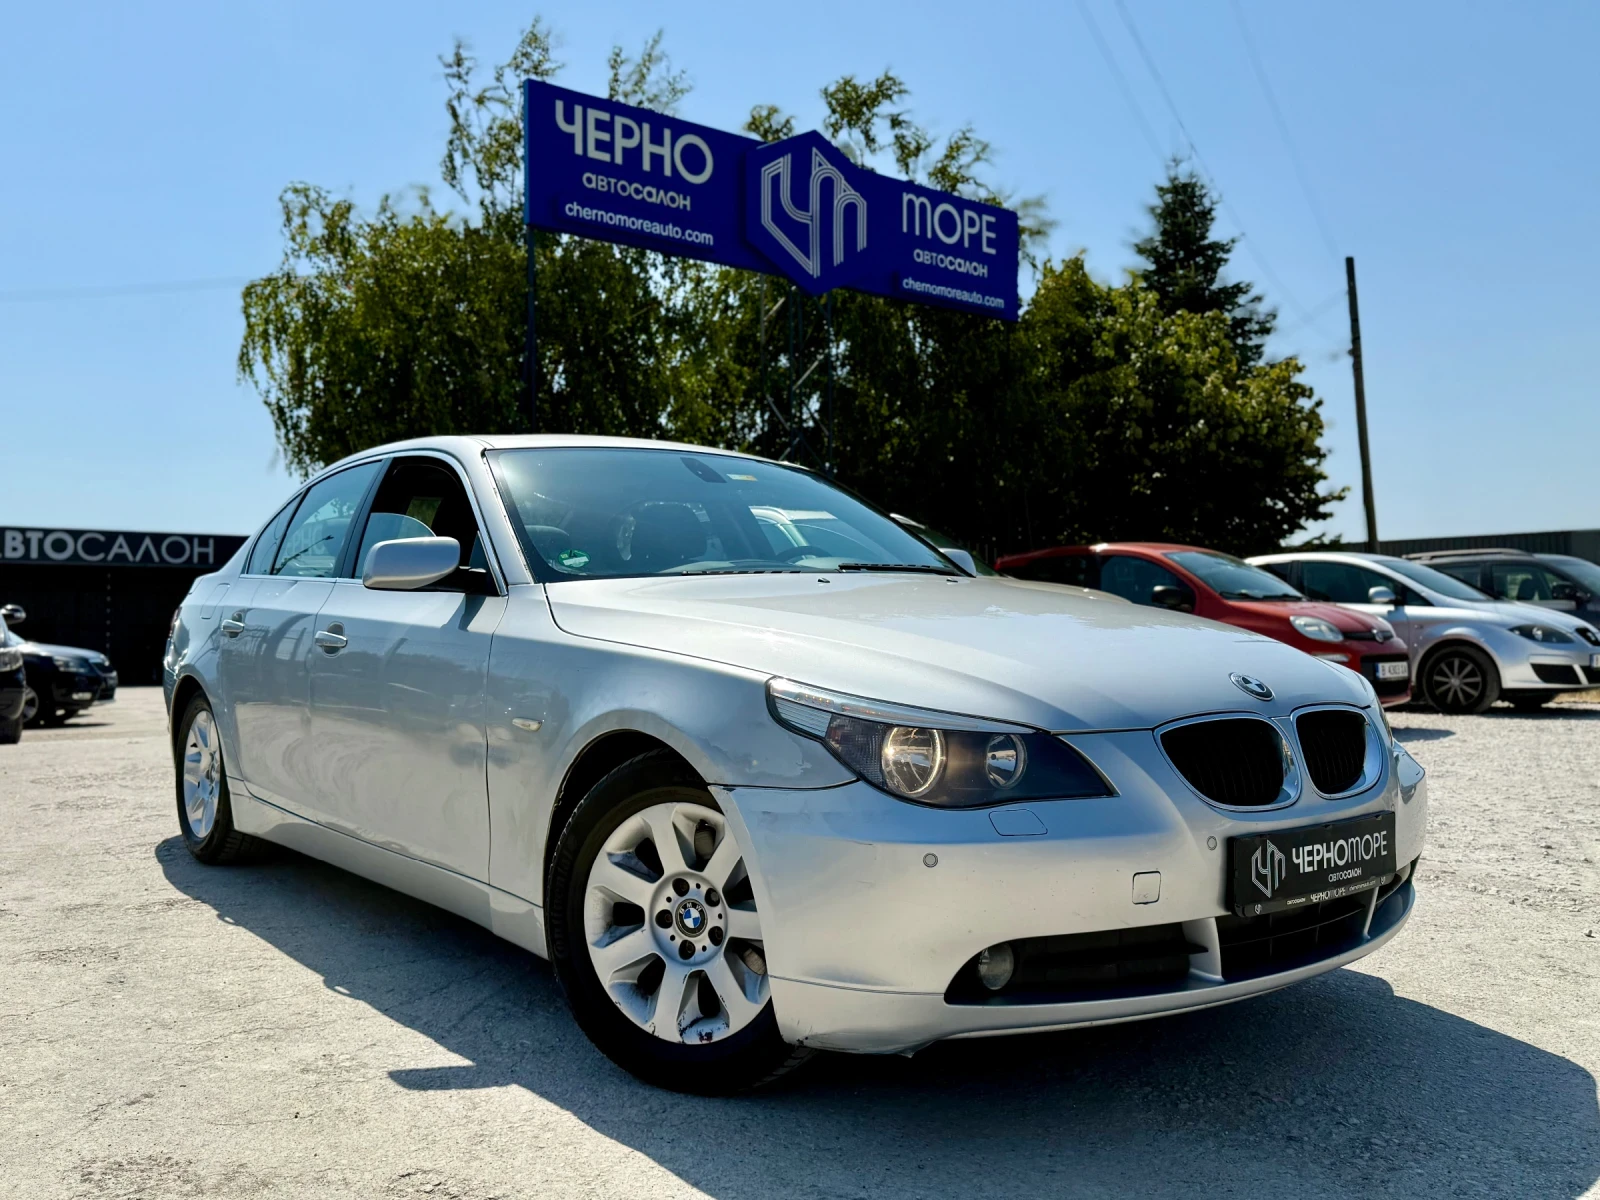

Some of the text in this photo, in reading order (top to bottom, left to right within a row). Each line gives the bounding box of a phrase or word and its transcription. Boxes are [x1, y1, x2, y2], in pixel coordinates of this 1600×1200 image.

[555, 99, 714, 184] ЧЕРНО
[582, 172, 691, 211] автосалон
[565, 201, 714, 246] chernomoreauto.com
[902, 277, 1005, 309] chernomoreauto.com
[0, 529, 214, 564] ВТОСАЛОН
